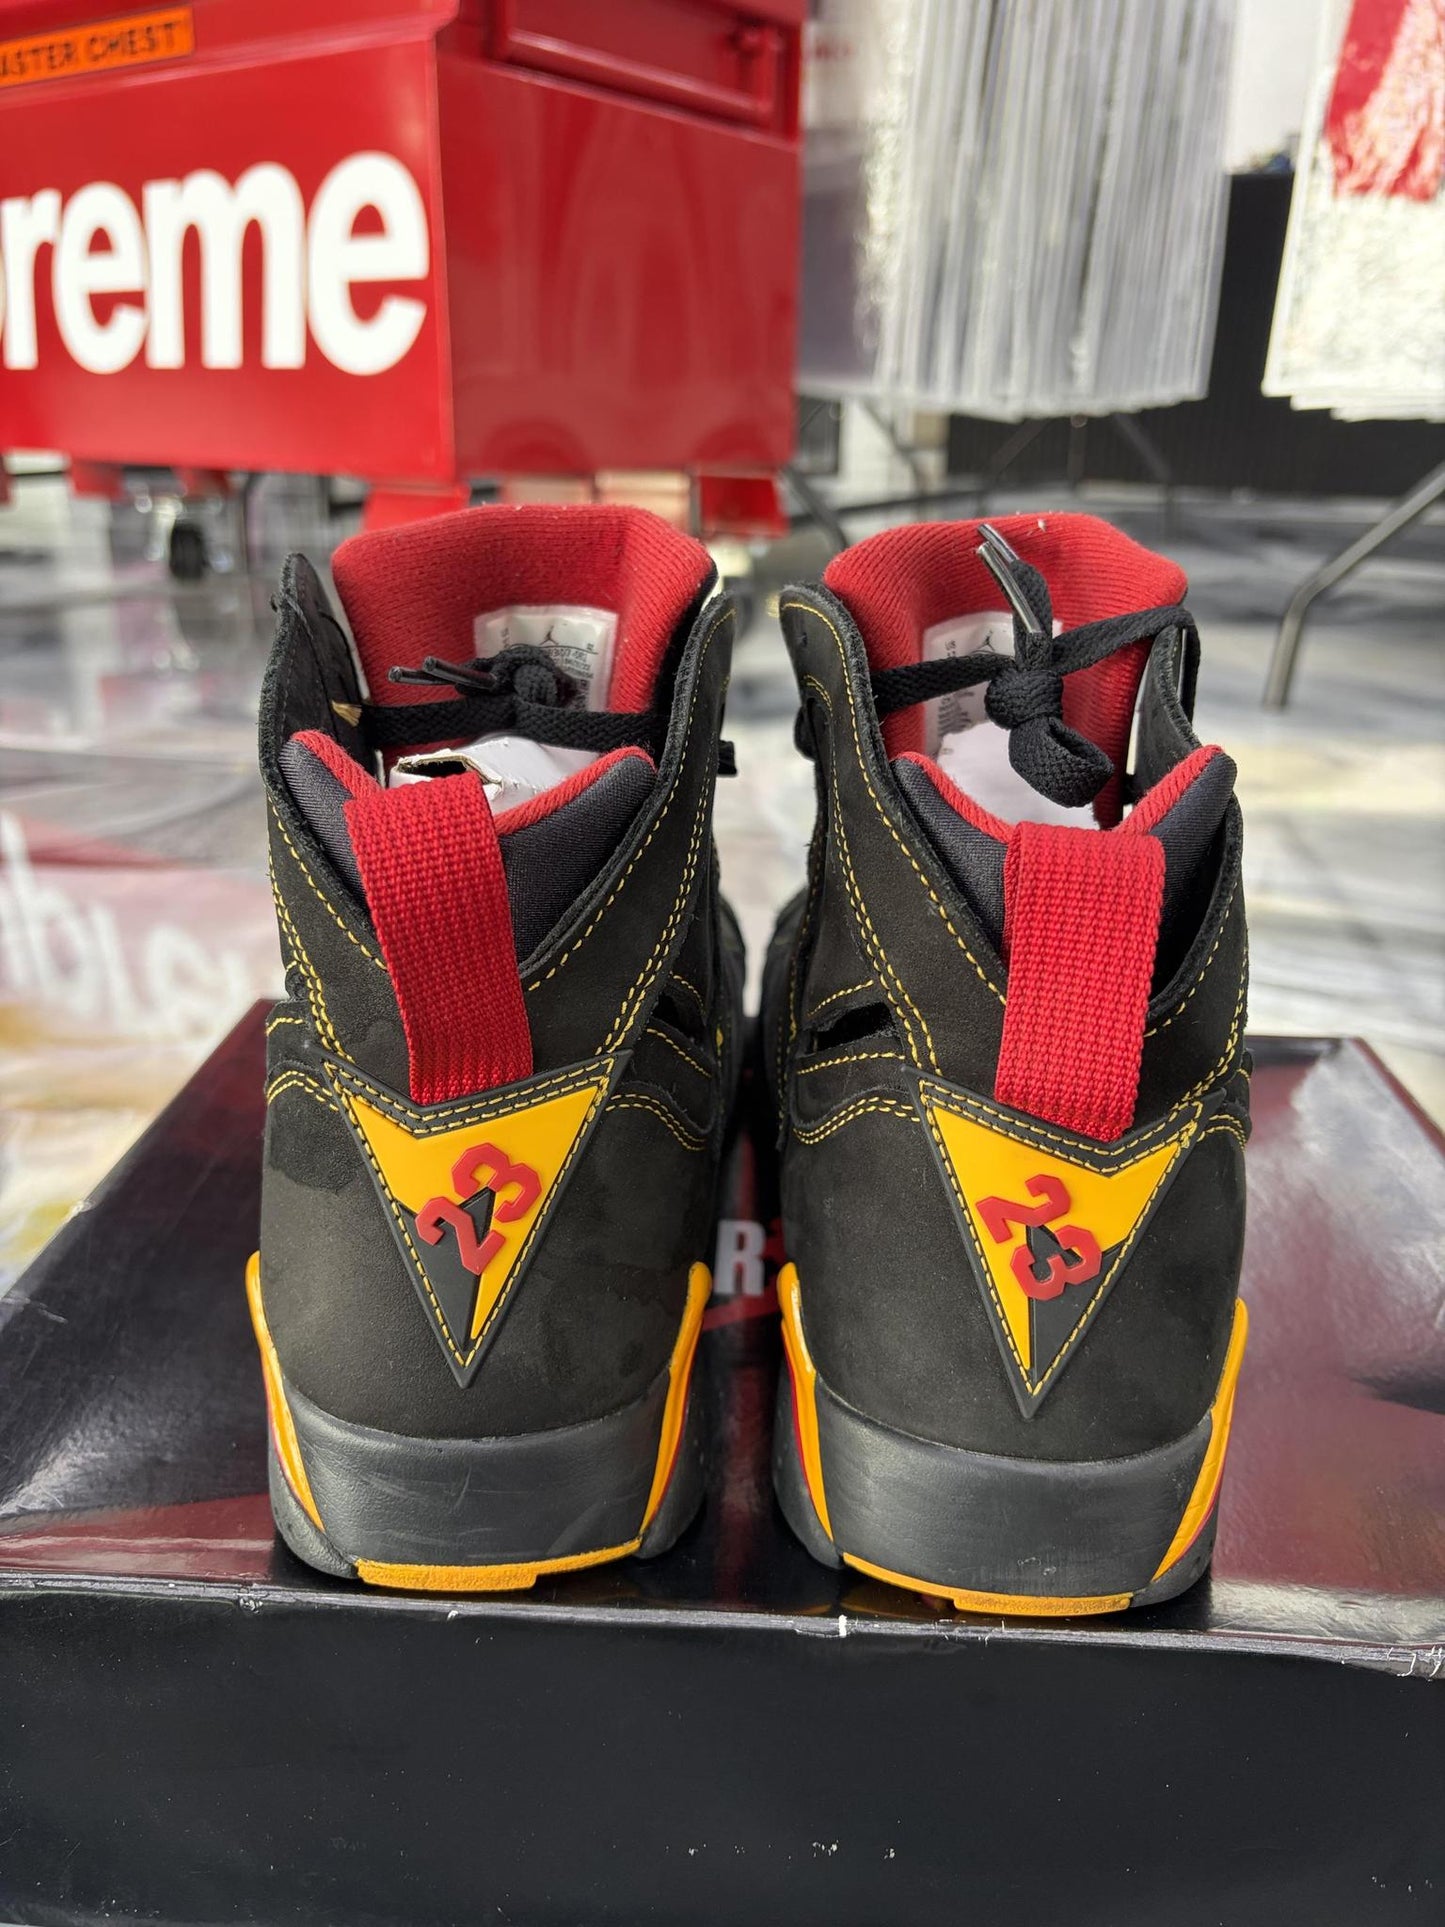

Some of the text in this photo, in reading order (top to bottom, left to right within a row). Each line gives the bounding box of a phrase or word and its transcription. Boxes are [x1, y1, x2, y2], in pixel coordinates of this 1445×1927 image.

[88, 22, 180, 63] CHEST
[0, 150, 430, 376] reme
[415, 1142, 542, 1276] 23
[975, 1174, 1102, 1300] 23
